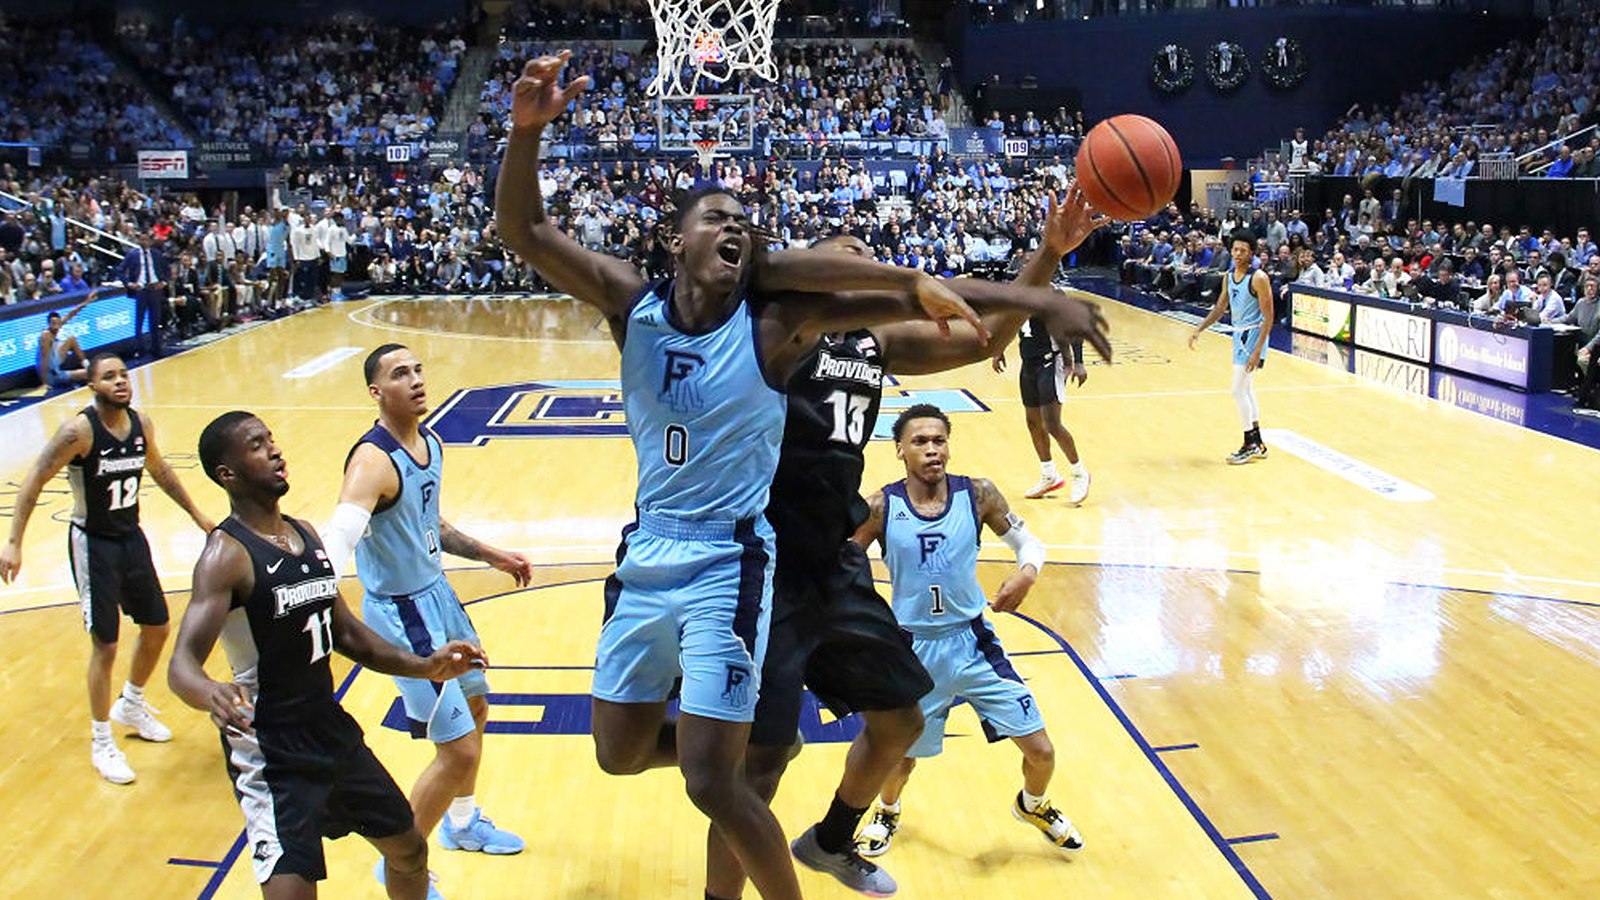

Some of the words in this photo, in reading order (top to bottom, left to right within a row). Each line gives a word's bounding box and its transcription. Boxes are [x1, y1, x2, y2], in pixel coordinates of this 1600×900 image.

[140, 157, 185, 170] ESPN
[389, 148, 408, 159] 107
[1006, 141, 1027, 155] 109
[823, 389, 872, 445] 13
[663, 422, 689, 468] 0
[107, 476, 138, 511] 12
[929, 584, 945, 616] 1
[301, 605, 333, 665] 11
